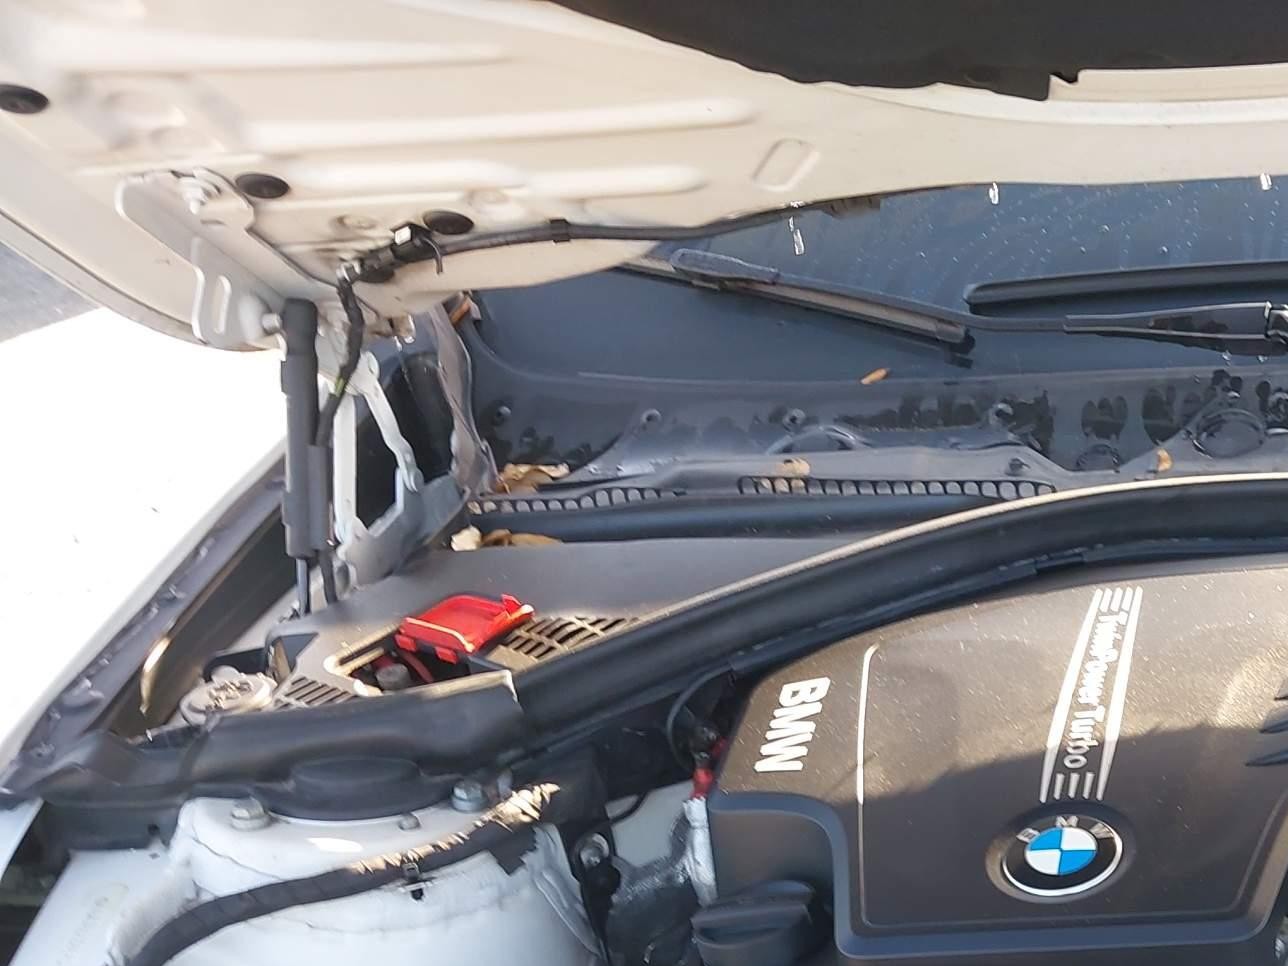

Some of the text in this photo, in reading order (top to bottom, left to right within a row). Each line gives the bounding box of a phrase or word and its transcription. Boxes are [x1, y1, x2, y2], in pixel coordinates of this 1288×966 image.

[754, 677, 831, 772] BMW
[1063, 704, 1106, 769] Turbo
[1016, 815, 1115, 843] BMW
